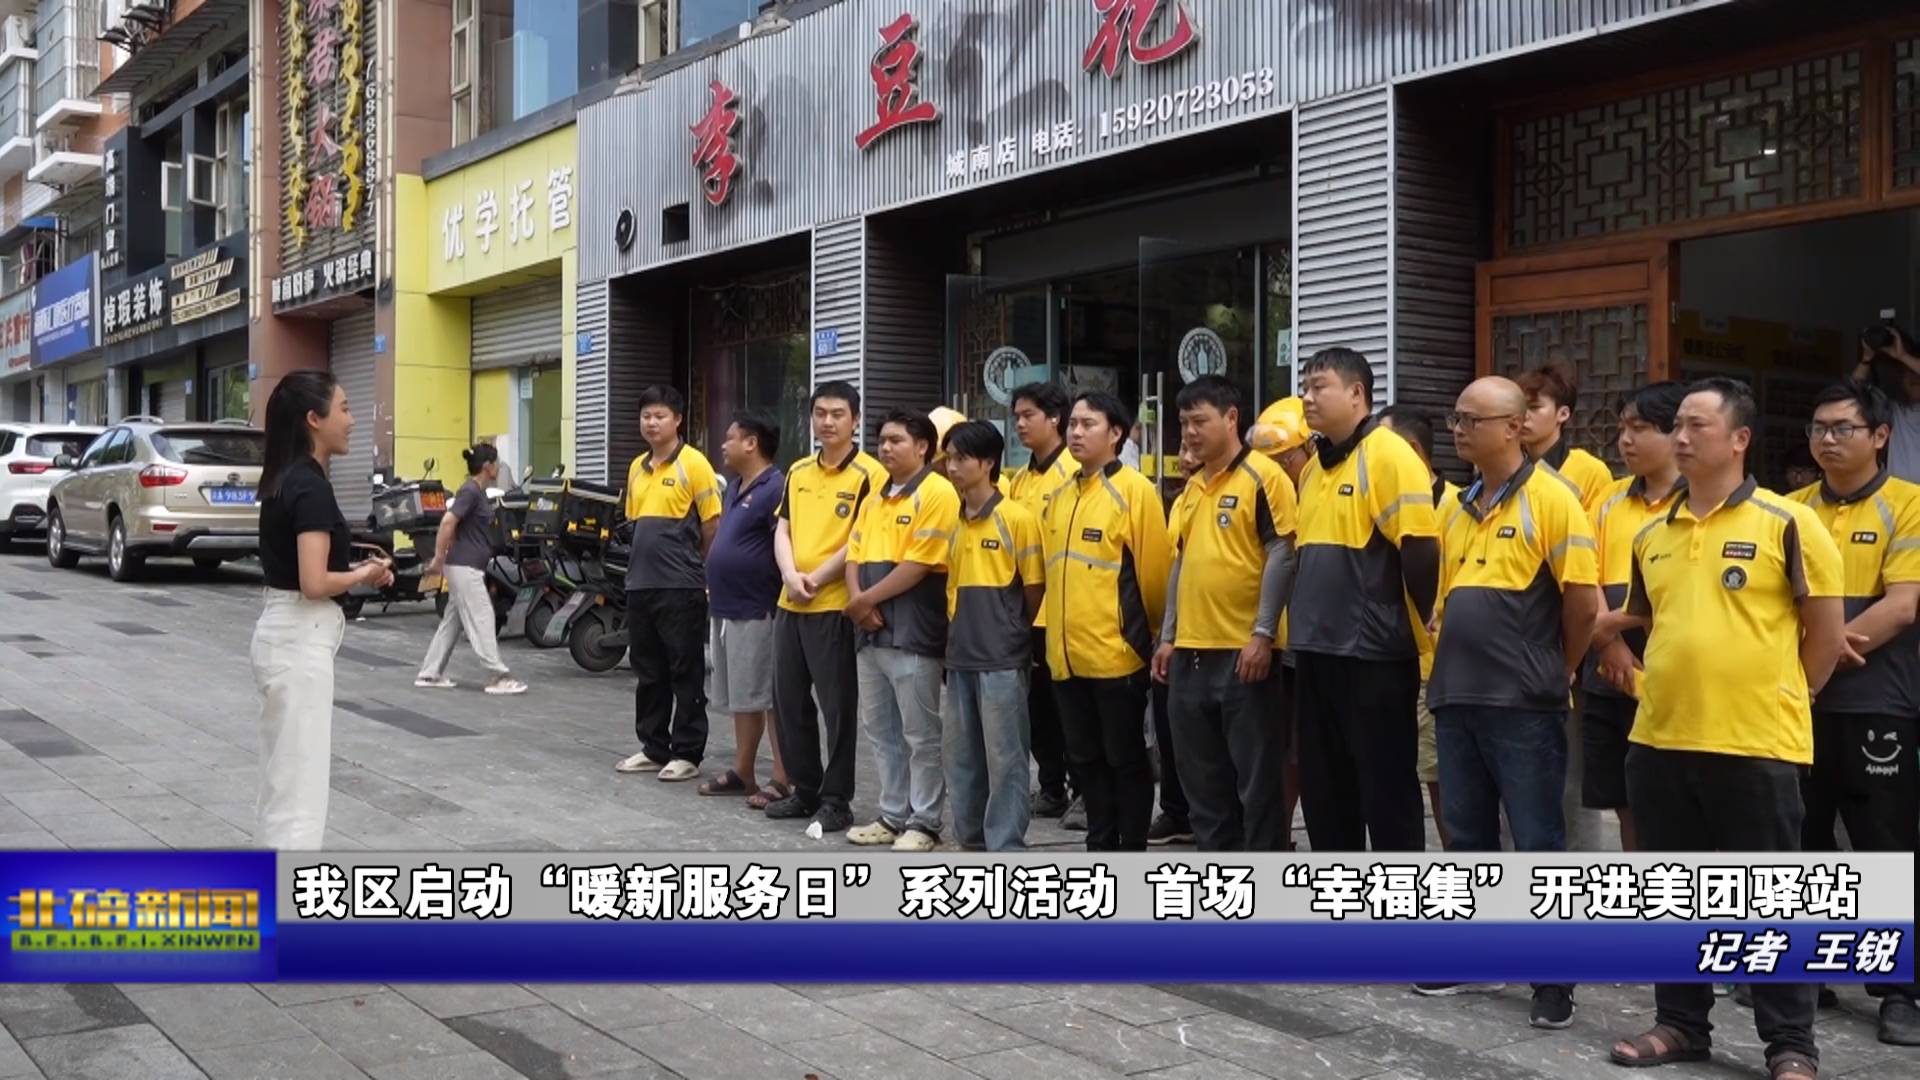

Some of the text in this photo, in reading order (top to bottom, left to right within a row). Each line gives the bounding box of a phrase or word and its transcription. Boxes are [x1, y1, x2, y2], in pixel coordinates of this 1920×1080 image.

[946, 136, 1017, 178] 城南店
[1100, 67, 1274, 138] 15920723053
[442, 166, 574, 262] 优学托管
[323, 249, 372, 288] 火锅经典
